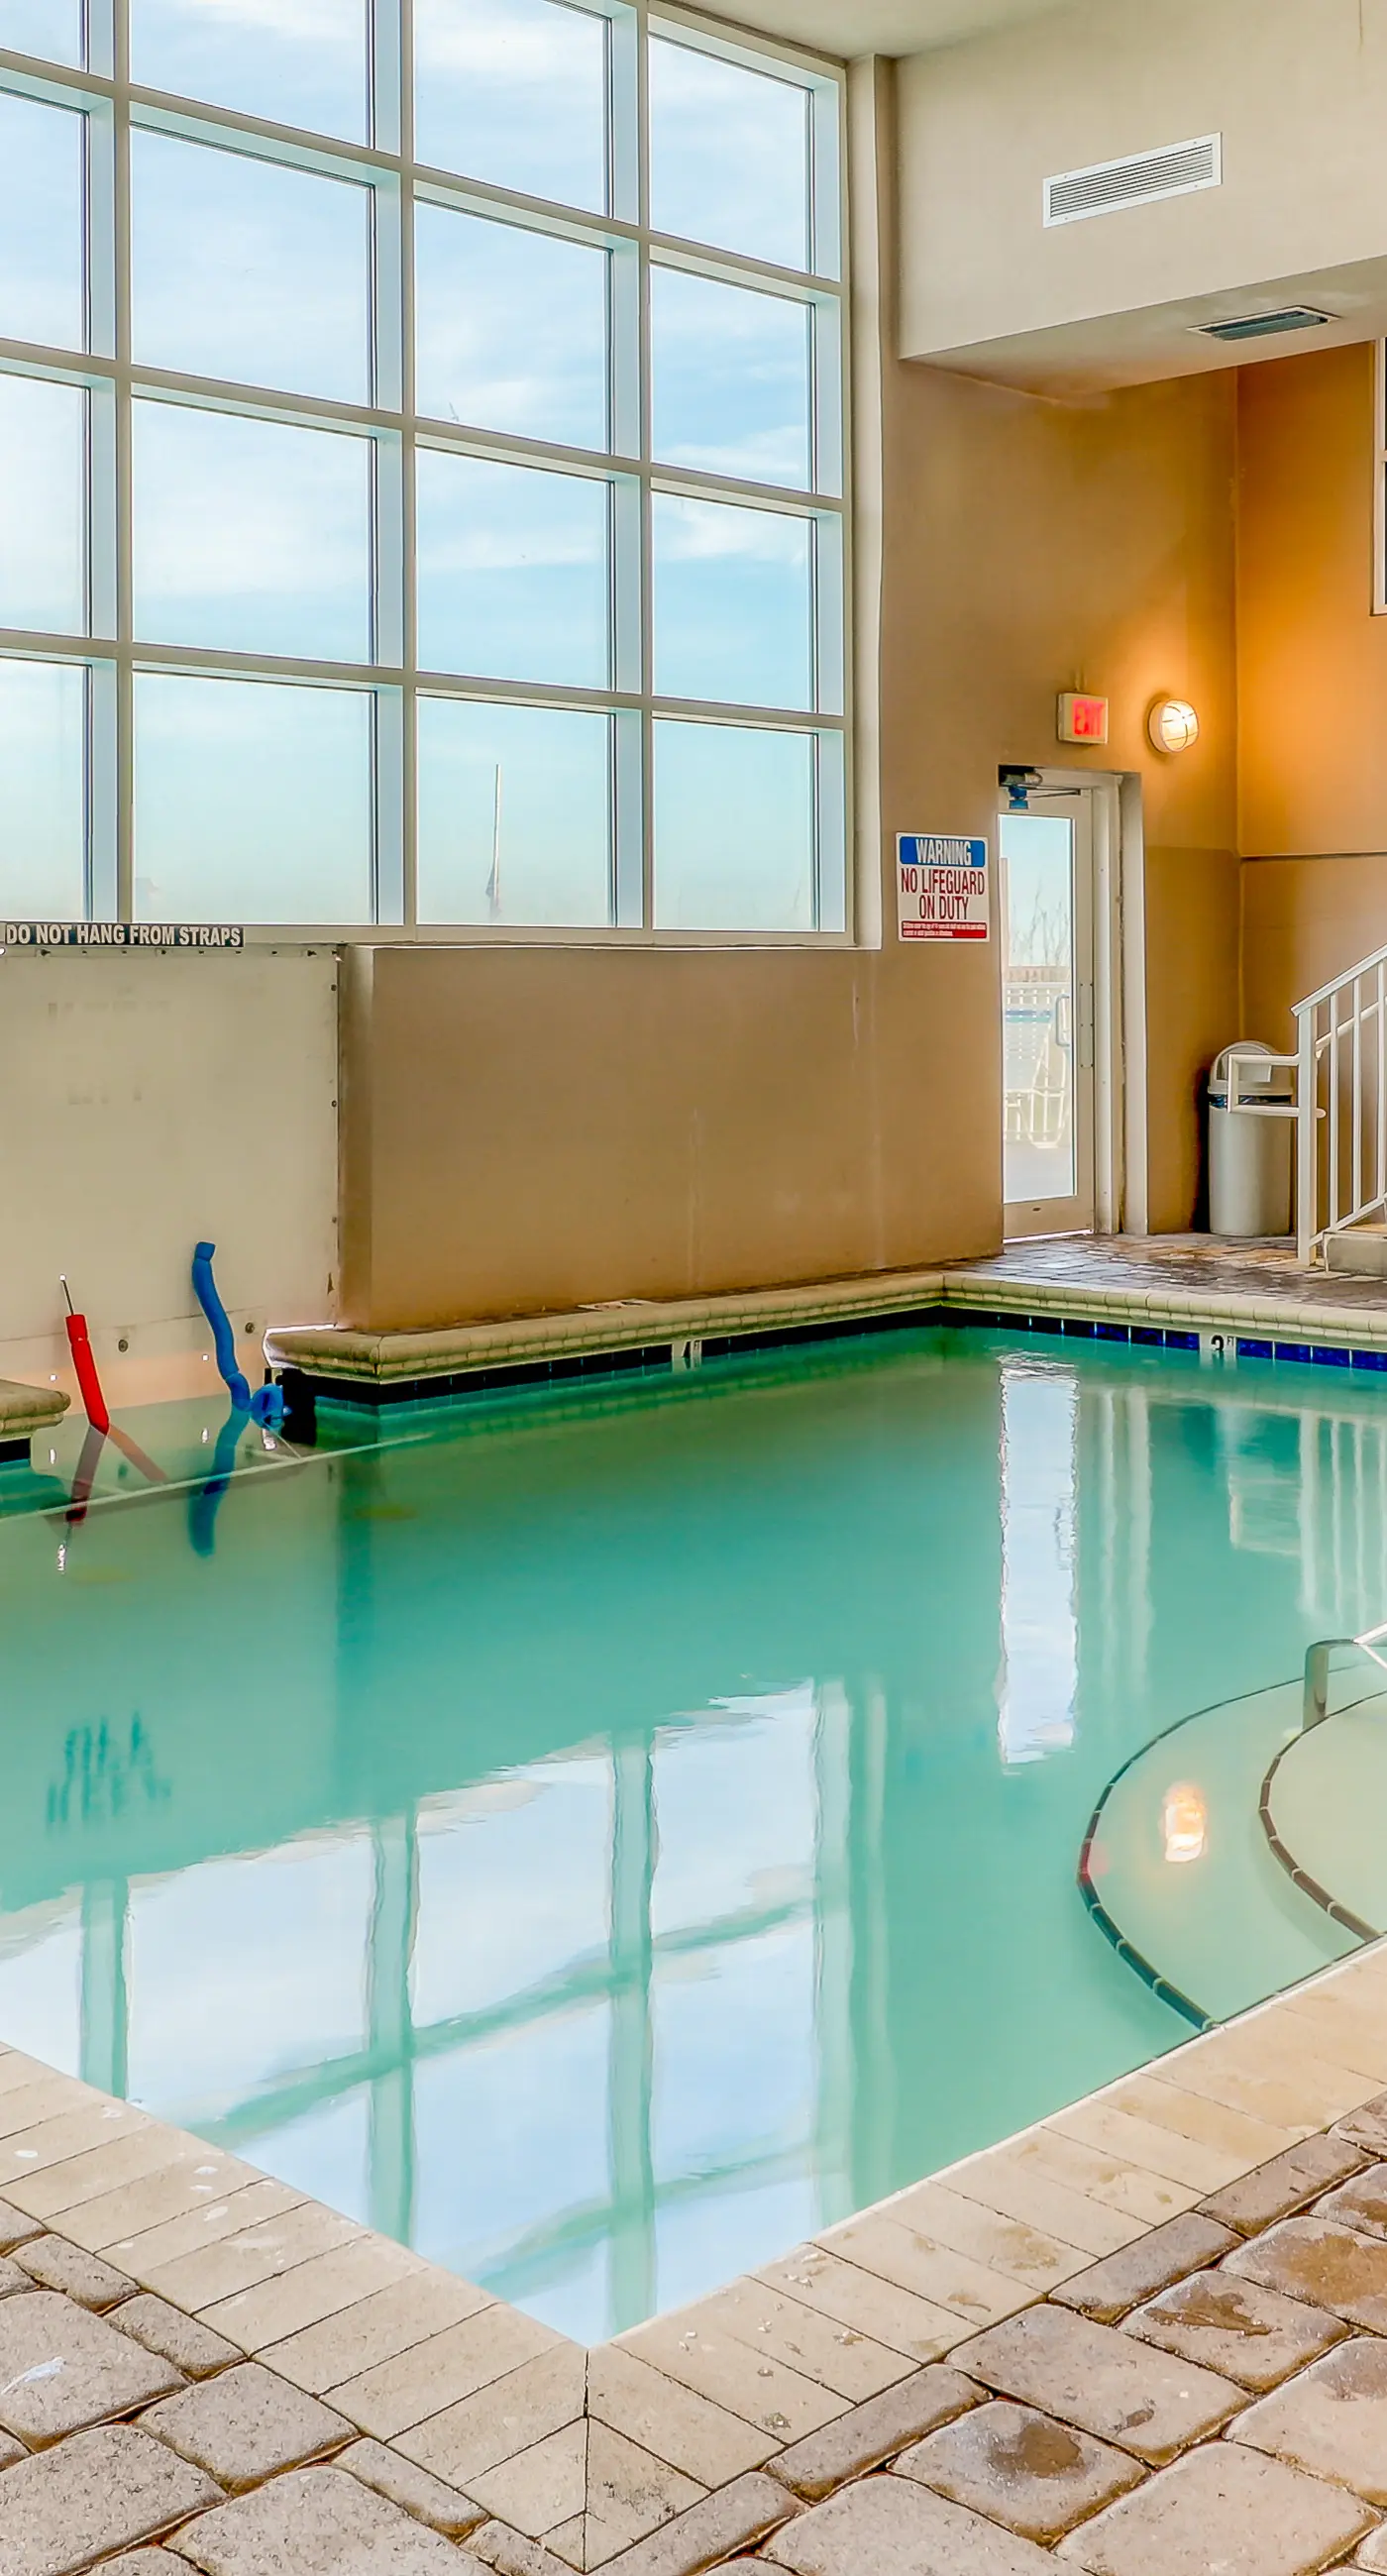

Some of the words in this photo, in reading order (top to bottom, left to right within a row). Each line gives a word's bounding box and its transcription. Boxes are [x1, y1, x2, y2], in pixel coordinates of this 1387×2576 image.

[1073, 699, 1104, 737] EXIT
[915, 838, 972, 866] WARNING
[901, 867, 918, 893] NO
[921, 869, 985, 895] LIFEGUARD
[918, 895, 935, 919] ON
[939, 896, 969, 919] DUTY
[6, 923, 31, 944] DO
[36, 923, 72, 944] NOT
[76, 924, 126, 944] HANG
[130, 924, 175, 945] FROM
[179, 925, 241, 946] STRAPS
